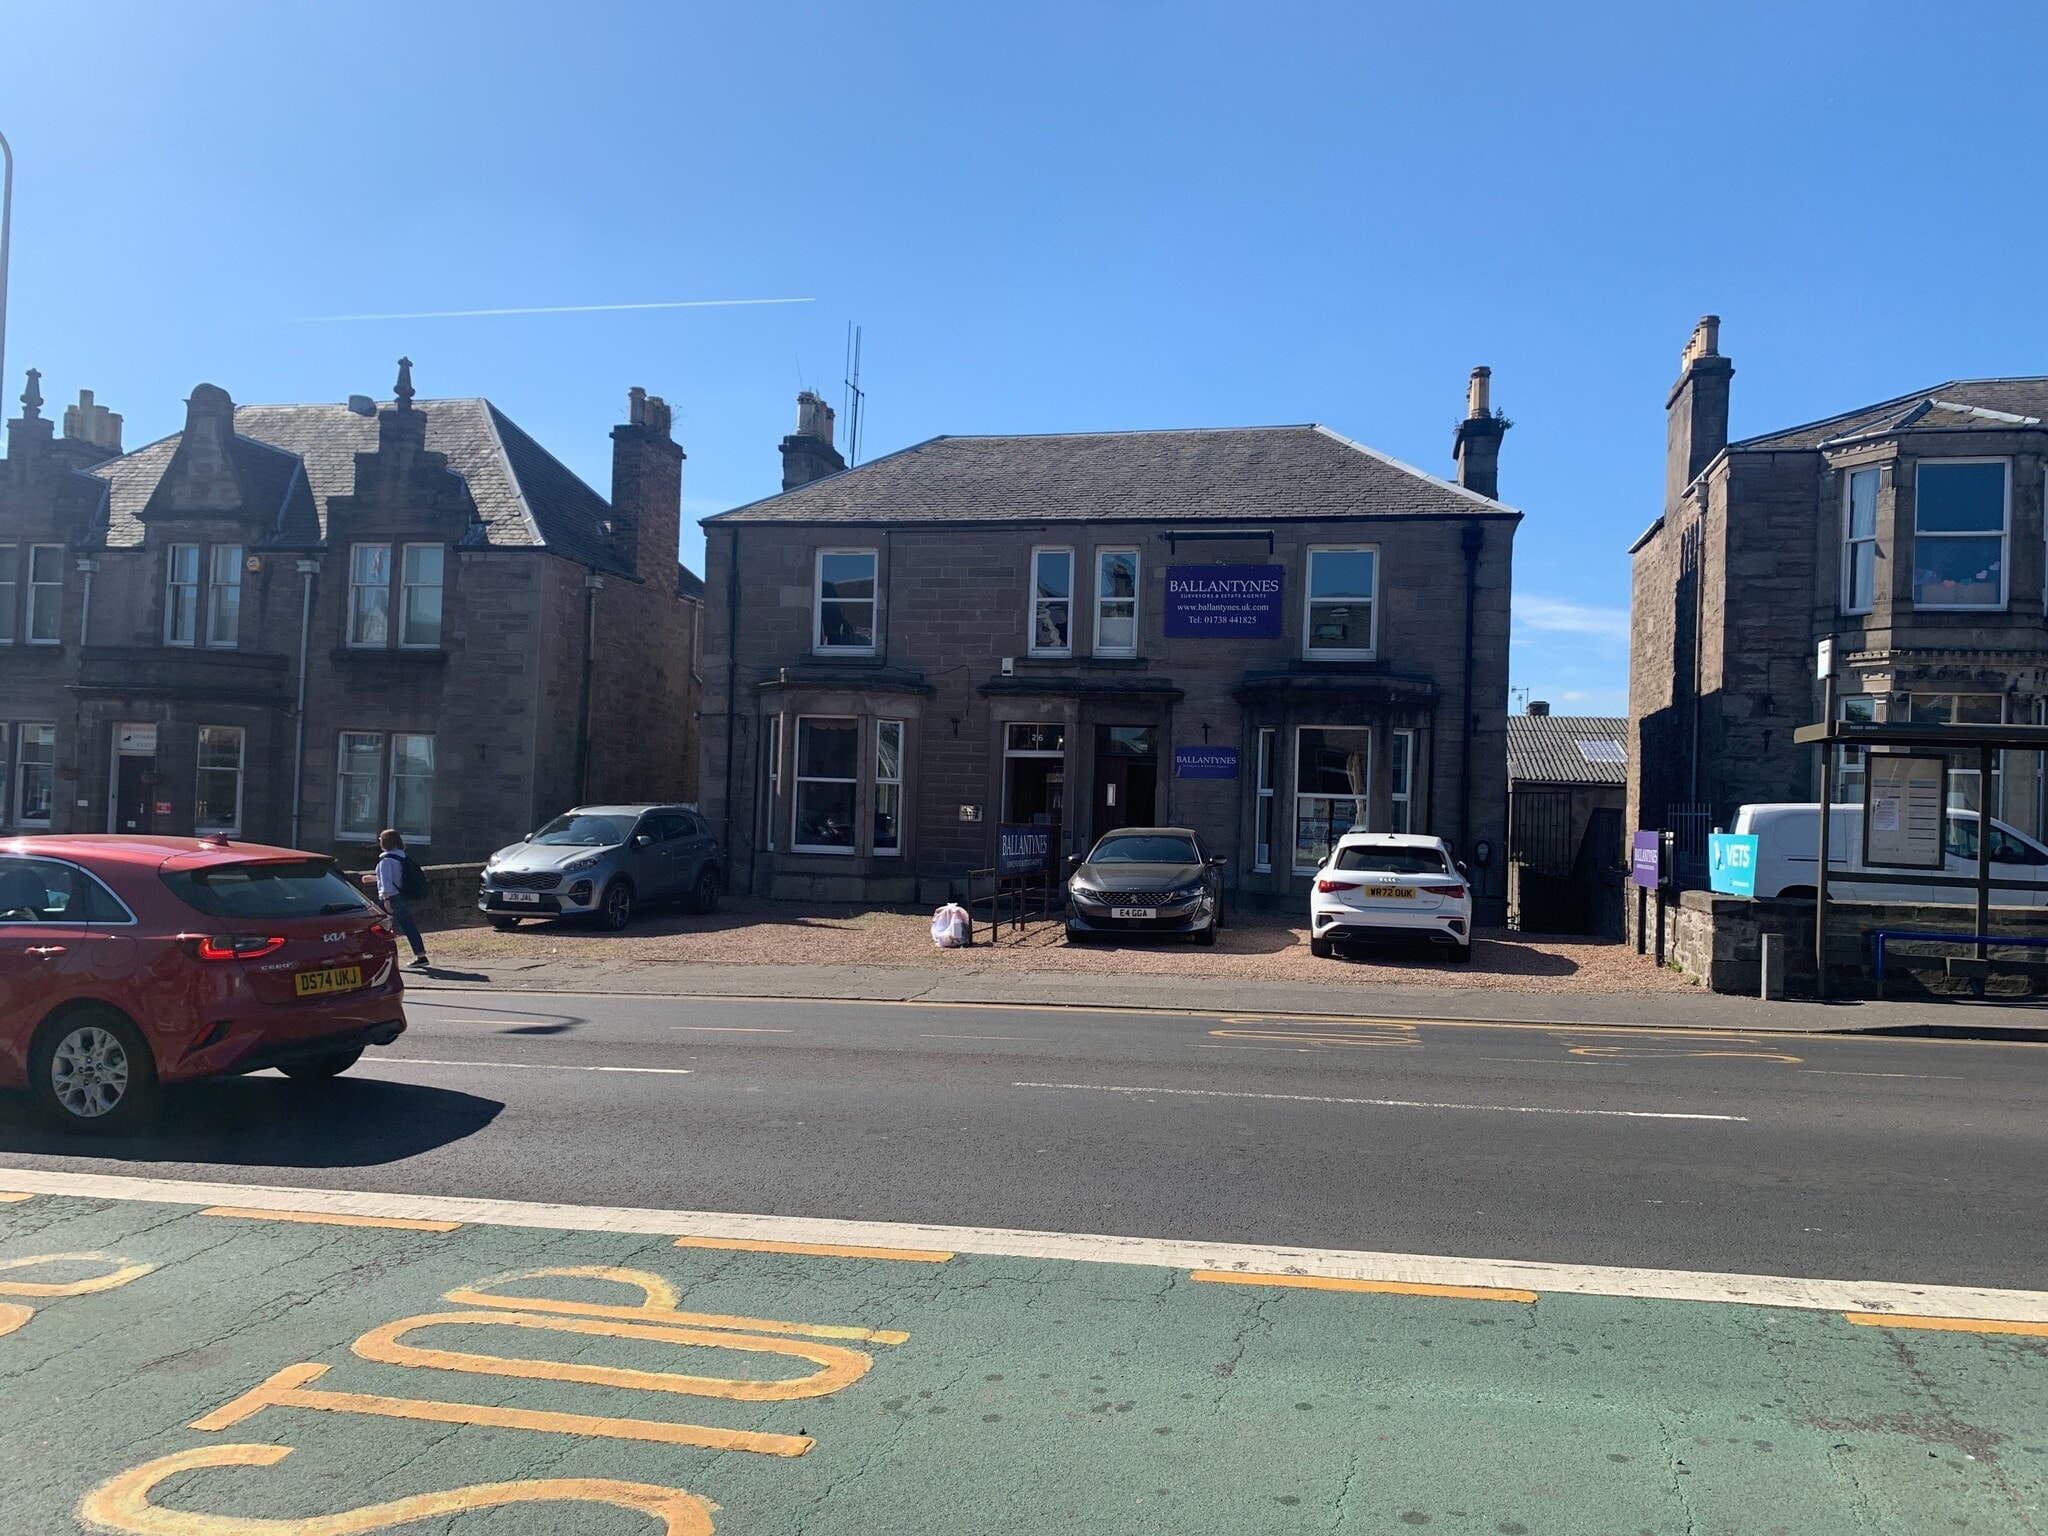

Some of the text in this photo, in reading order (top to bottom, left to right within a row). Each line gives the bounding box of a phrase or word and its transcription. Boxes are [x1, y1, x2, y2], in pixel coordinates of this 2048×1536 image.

[1170, 580, 1279, 592] BALLANTYNES
[1177, 603, 1269, 612] www.ballantynes.uk.com
[1189, 616, 1257, 624] Tel: 01738 441825
[1031, 734, 1044, 742] 26
[1176, 756, 1236, 764] BALLANTYNES
[1002, 834, 1048, 856] BALLANTYNES
[1726, 844, 1750, 868] VETS
[1370, 888, 1393, 896] WR72
[1120, 908, 1130, 916] E4
[301, 970, 358, 990] DS74 UKJ
